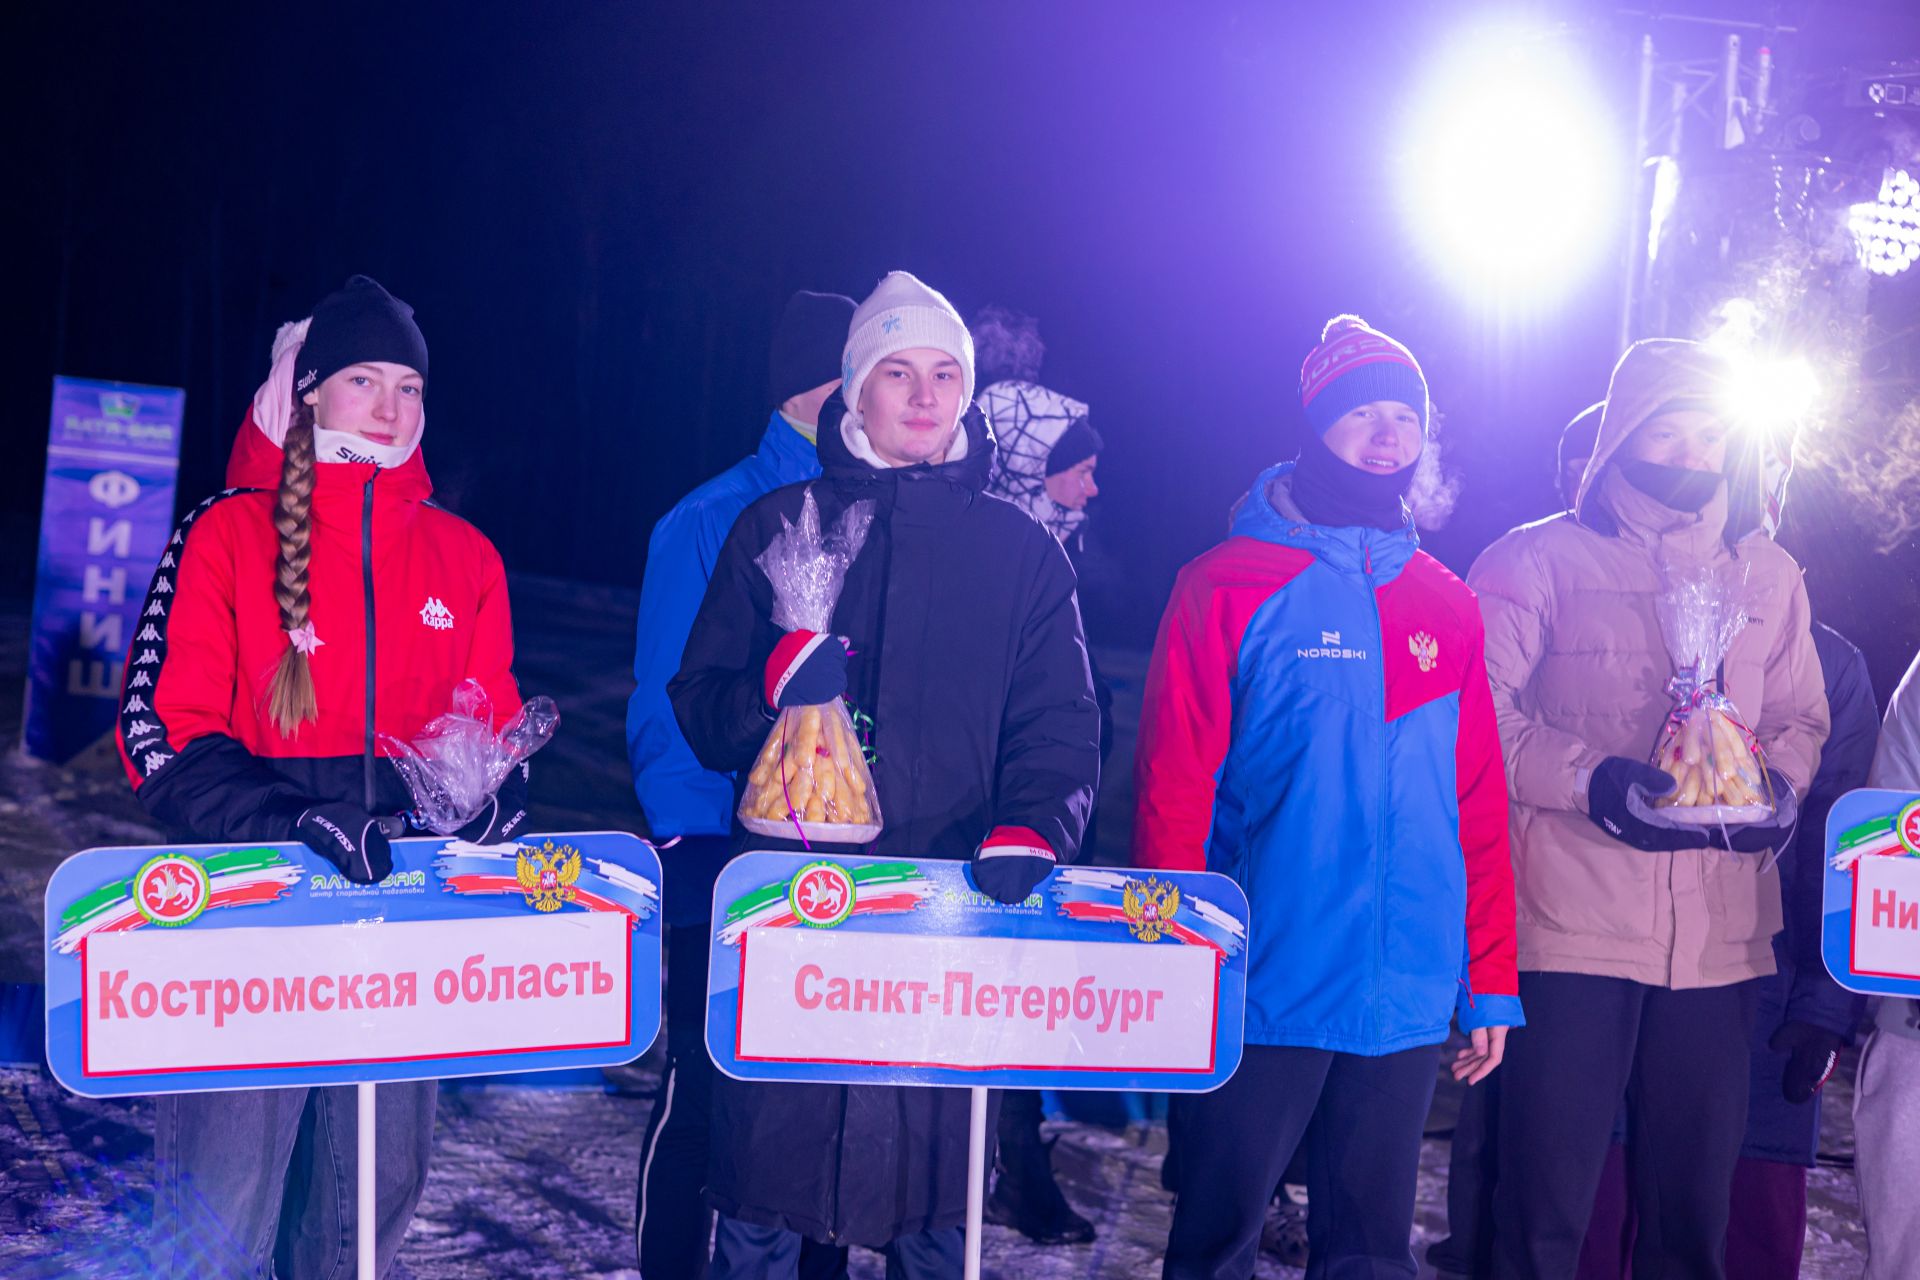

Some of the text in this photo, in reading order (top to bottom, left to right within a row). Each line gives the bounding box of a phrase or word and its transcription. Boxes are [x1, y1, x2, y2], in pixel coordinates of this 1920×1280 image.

[67, 470, 141, 697] ФИНИШ
[422, 613, 454, 631] Kappa
[1297, 648, 1367, 661] NORDSKI
[98, 953, 614, 1027] Костромская область
[794, 962, 1163, 1033] Санкт-Петербург
